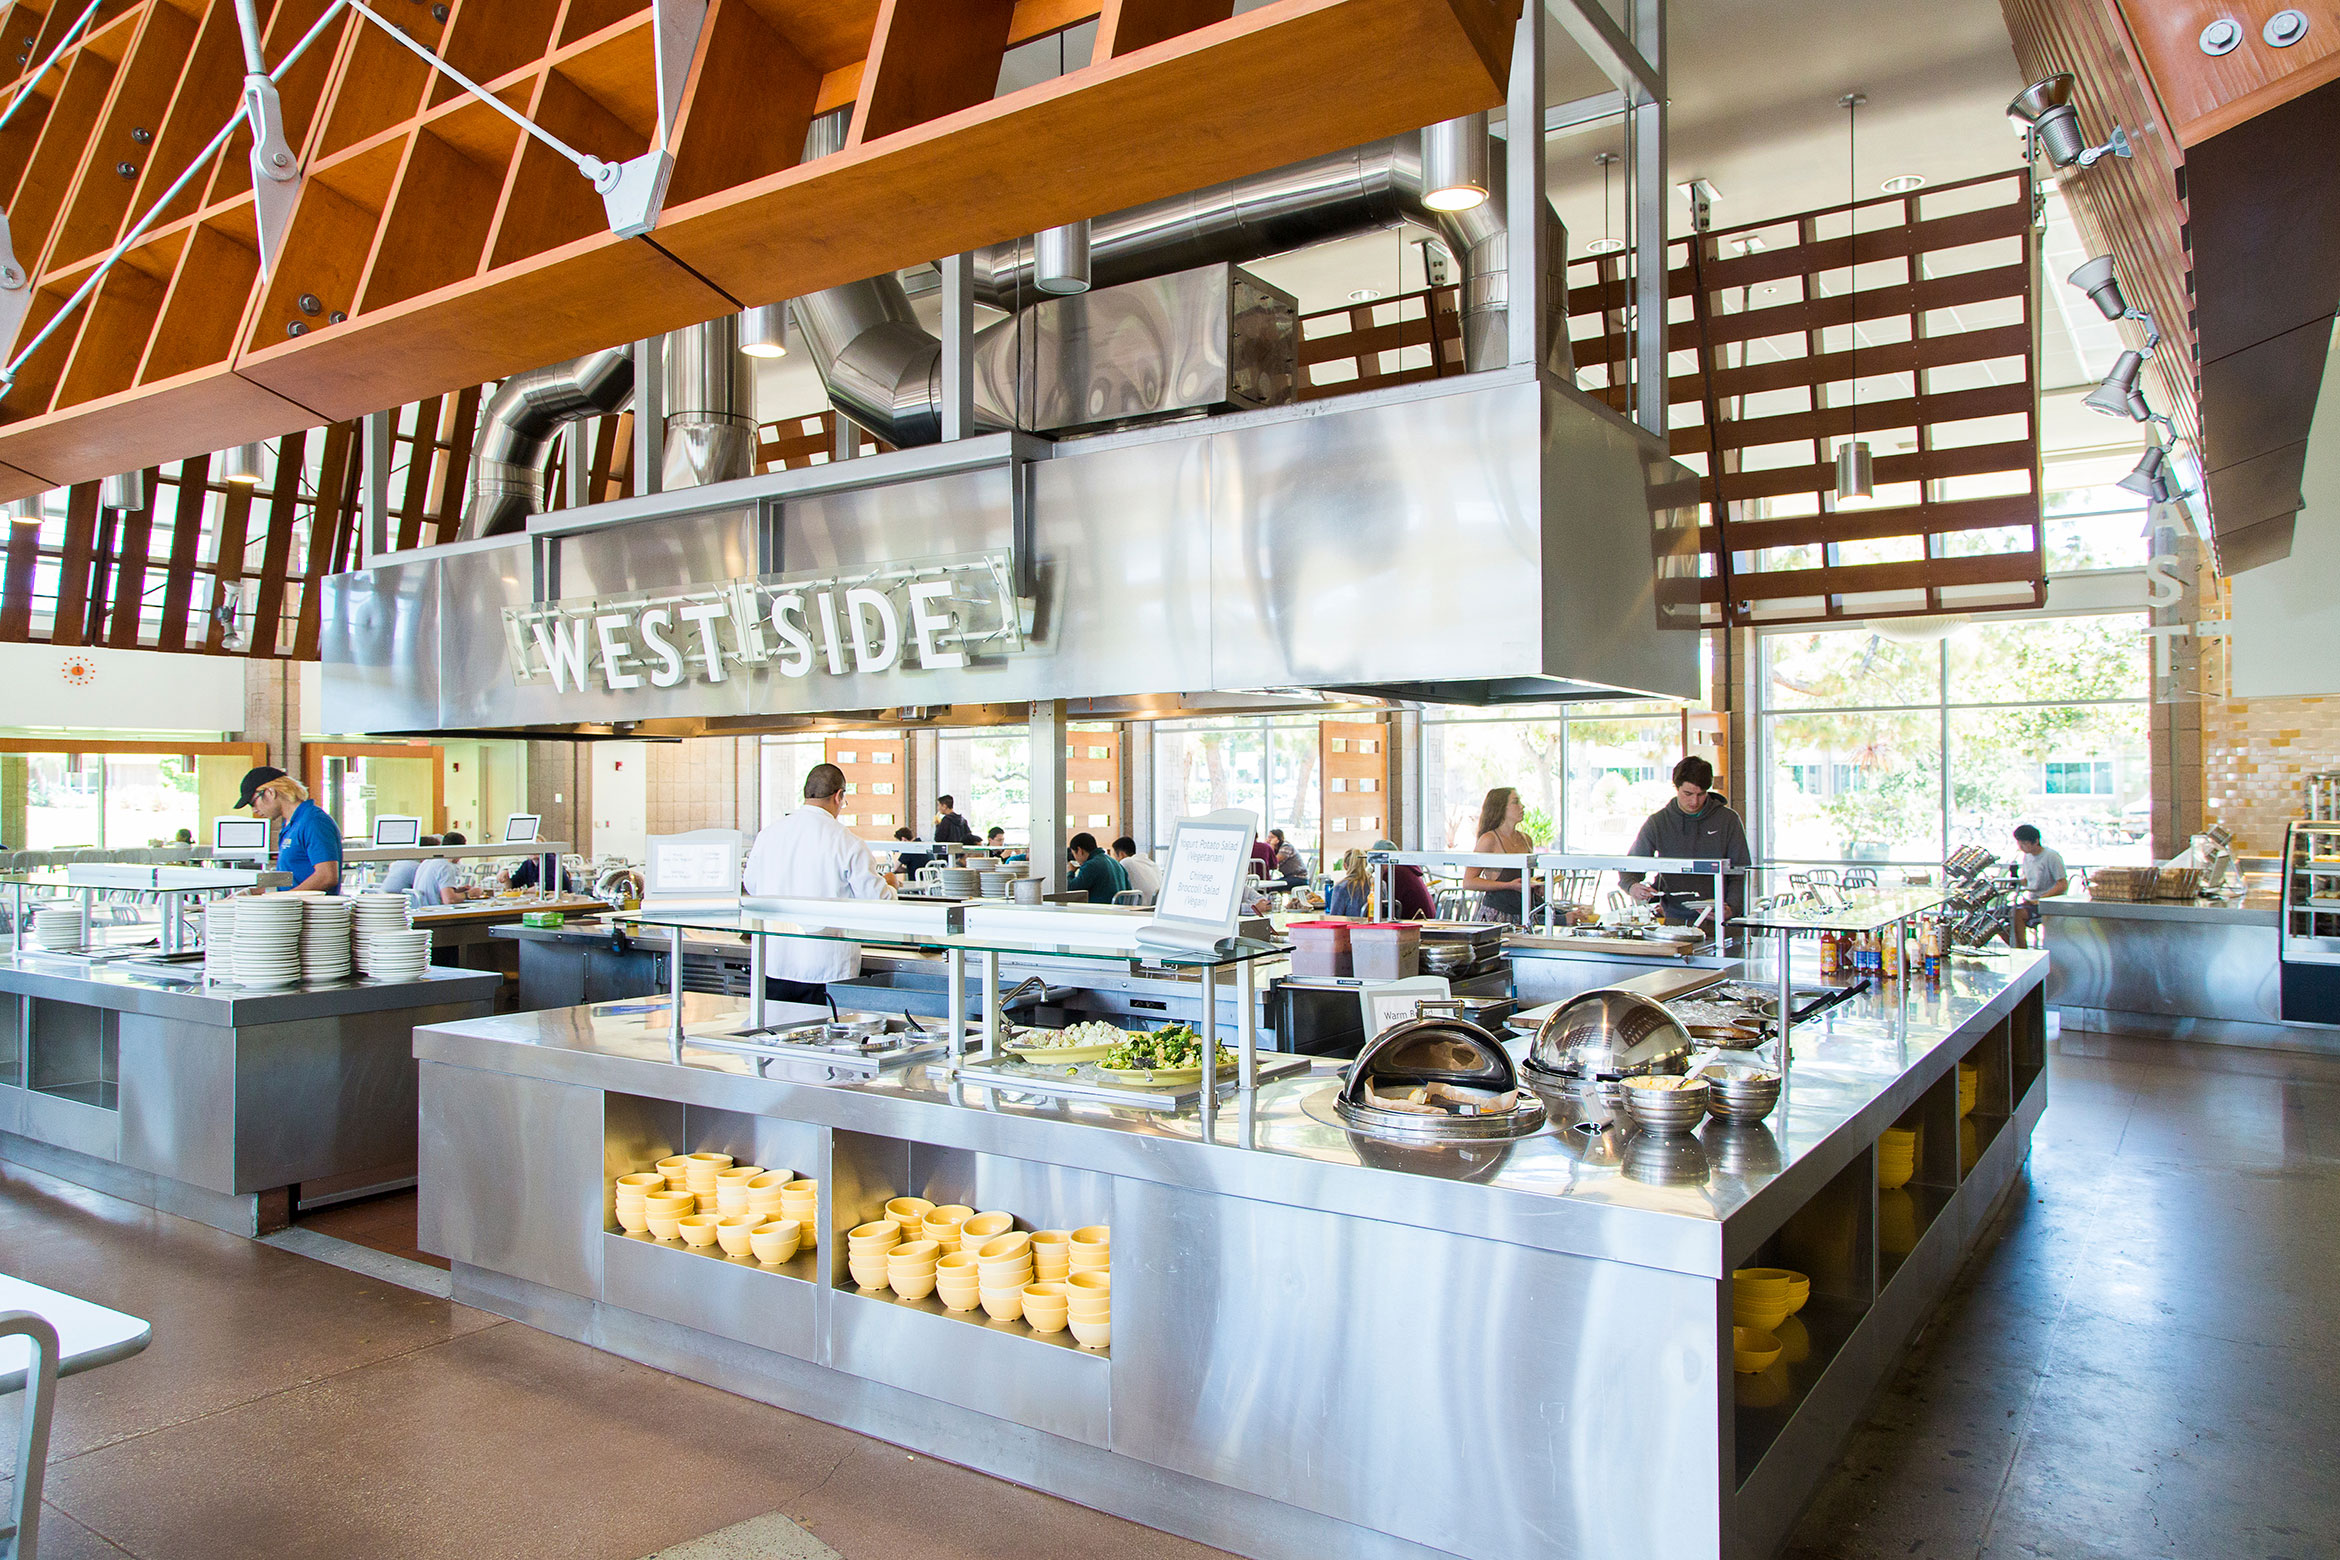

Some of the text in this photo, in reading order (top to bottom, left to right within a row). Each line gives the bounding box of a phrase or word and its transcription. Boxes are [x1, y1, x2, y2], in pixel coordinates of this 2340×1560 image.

[532, 580, 972, 694] WEST SIDE
[1181, 839, 1239, 851] Yogurt Potato Salad
[1190, 870, 1213, 882] Chinese
[1177, 882, 1220, 896] Broccoli Salad
[1384, 1010, 1408, 1020] Warm
